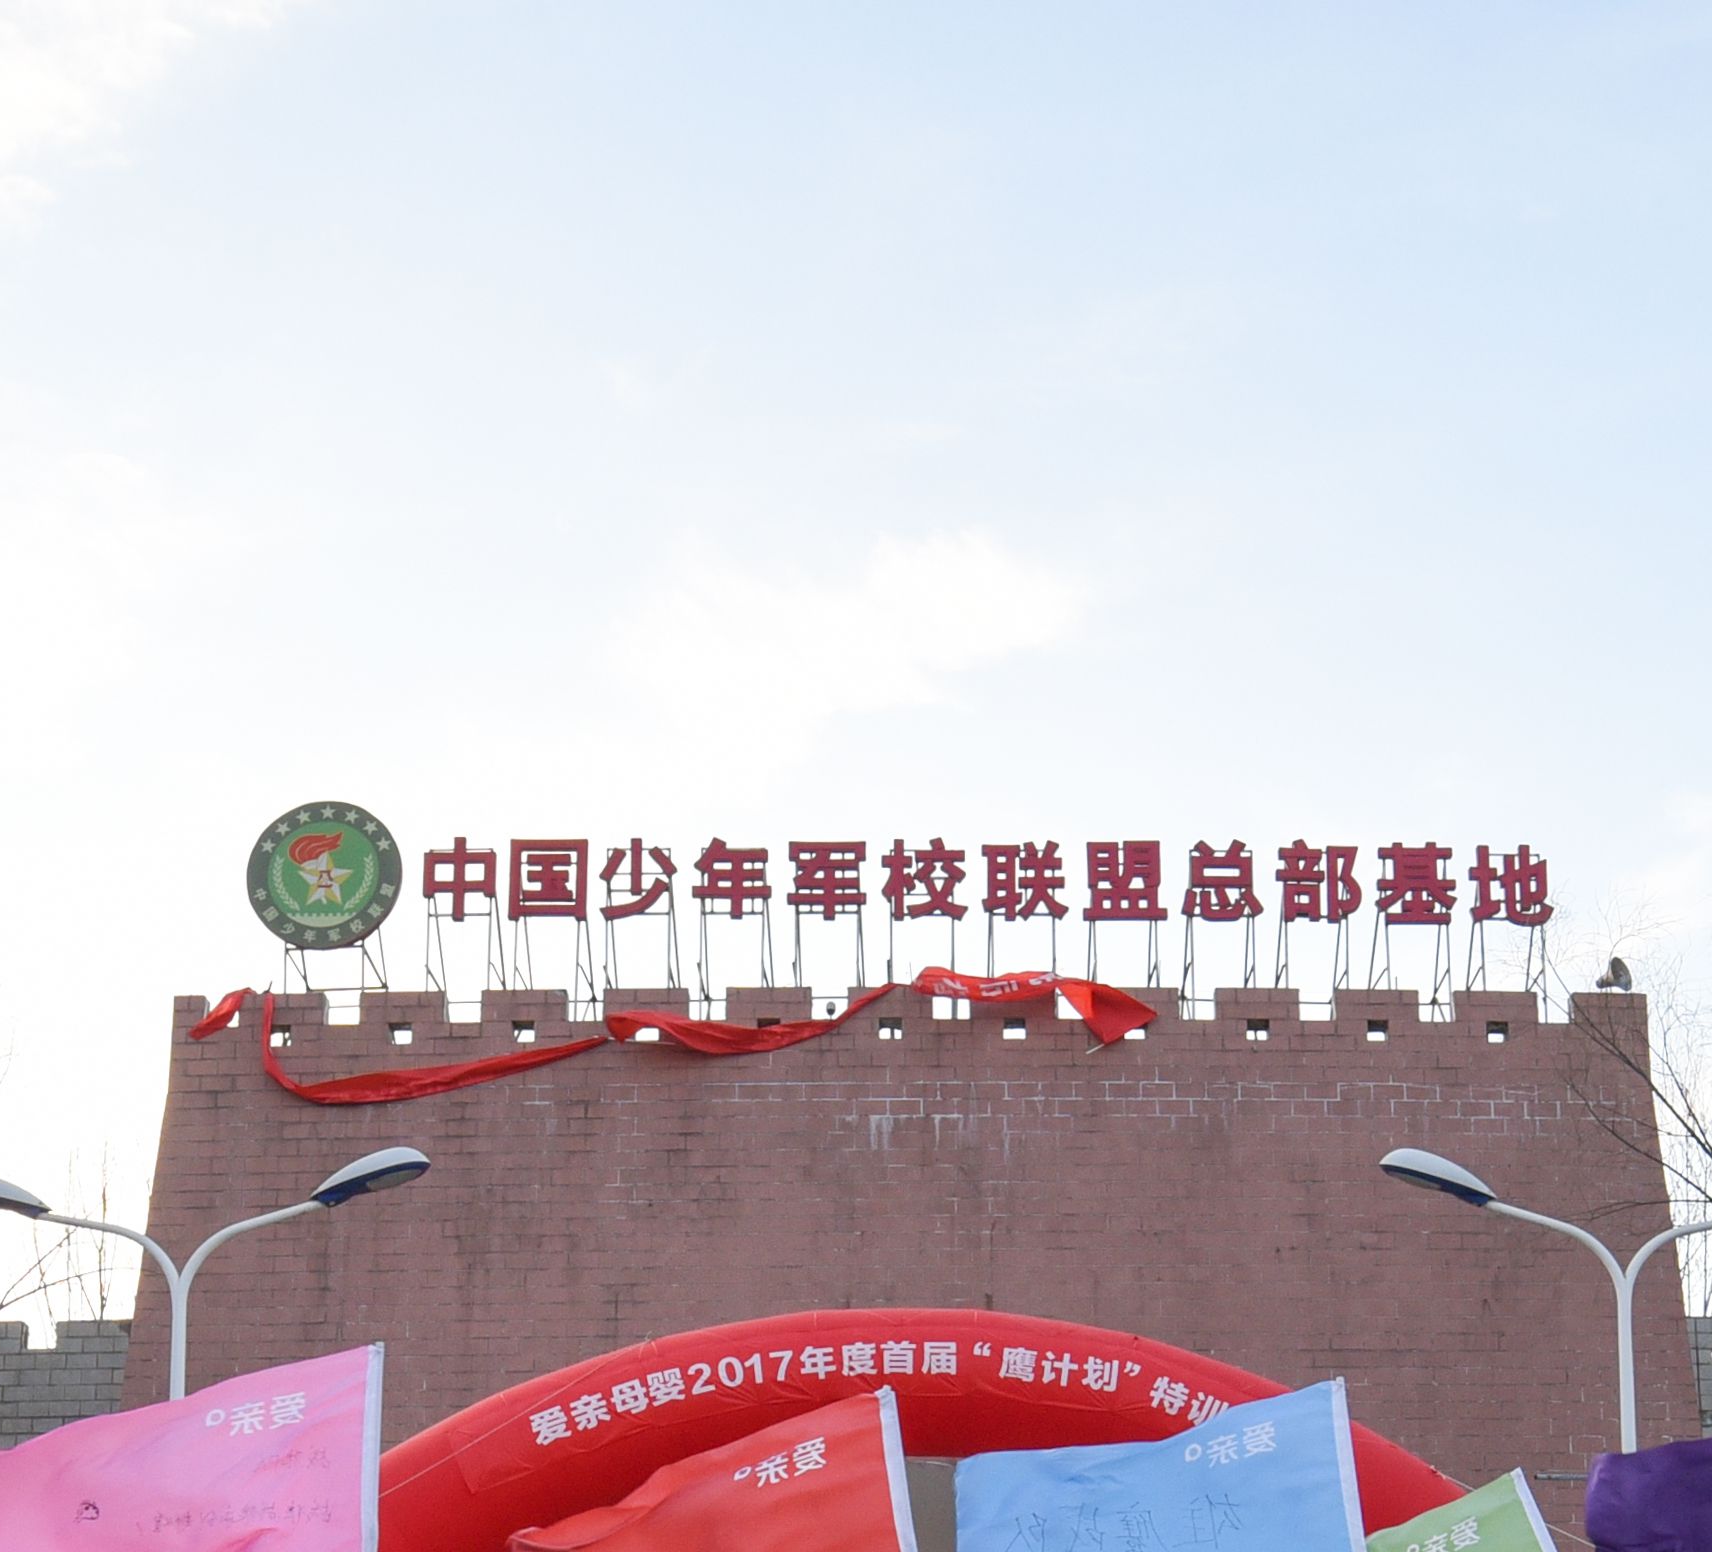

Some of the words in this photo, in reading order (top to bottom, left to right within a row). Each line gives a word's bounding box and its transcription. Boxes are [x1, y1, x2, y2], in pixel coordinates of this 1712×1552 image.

[253, 883, 396, 942] 中国少年军校联盟
[422, 836, 1554, 926] 中国少年军校联盟总部基地
